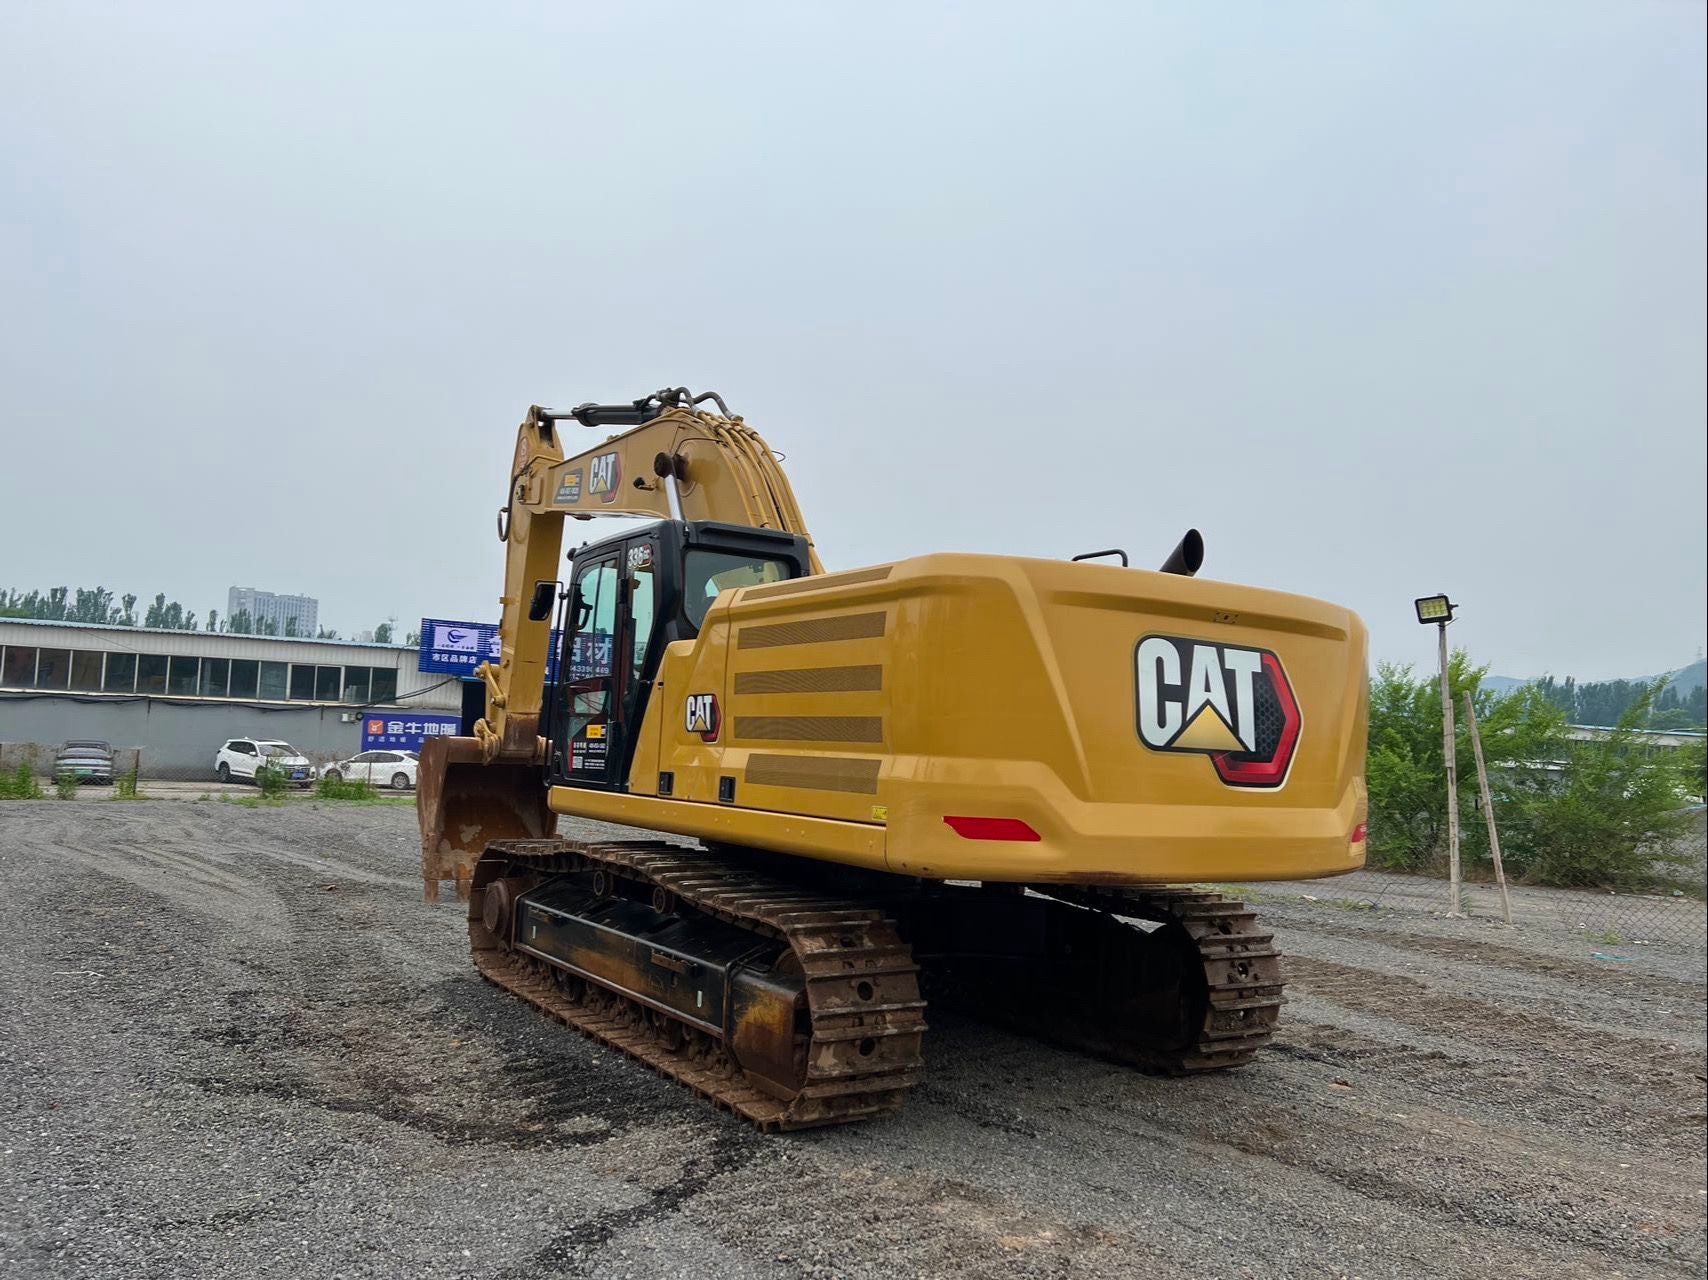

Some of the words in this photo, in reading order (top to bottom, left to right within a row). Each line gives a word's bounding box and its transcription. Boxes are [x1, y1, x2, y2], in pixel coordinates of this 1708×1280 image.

[589, 454, 616, 493] CAT
[627, 546, 644, 568] 336
[432, 652, 478, 664] 市区品牌店
[1138, 637, 1262, 752] CAT
[686, 695, 713, 731] CAT
[387, 720, 457, 736] 金牛地暖
